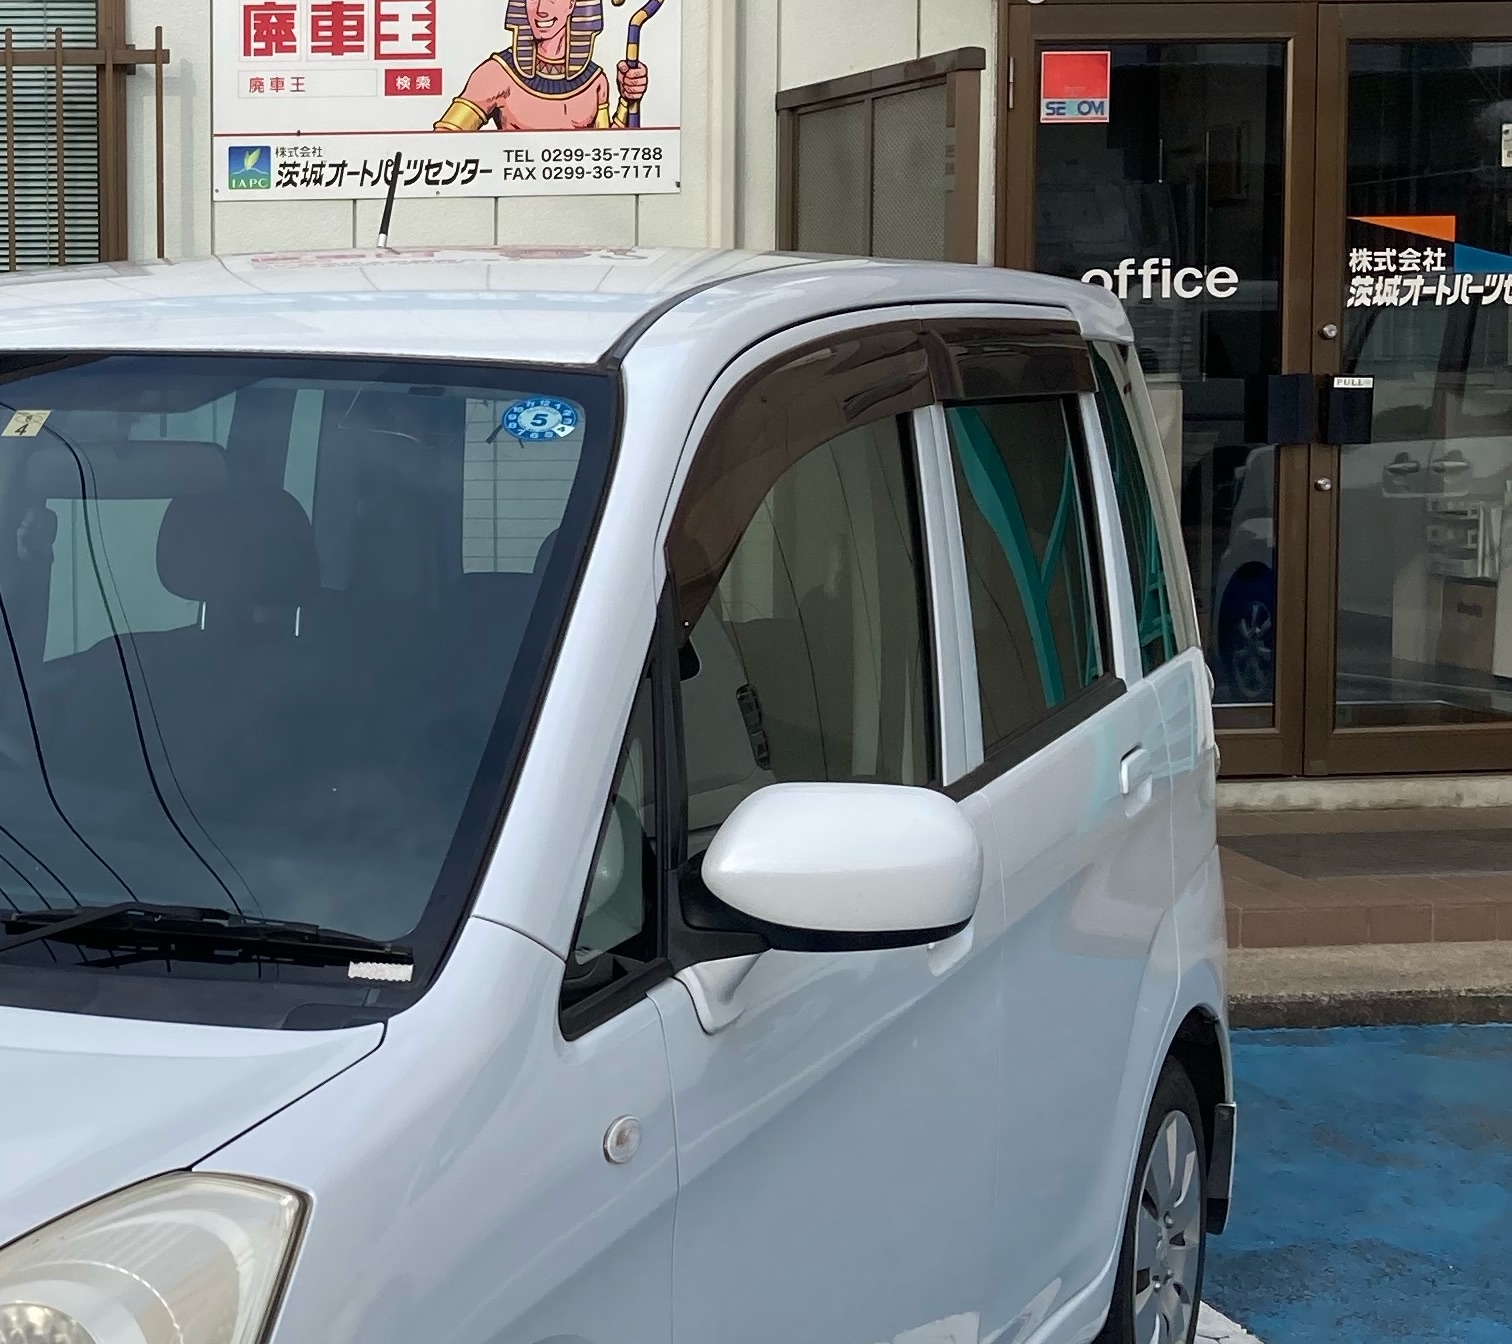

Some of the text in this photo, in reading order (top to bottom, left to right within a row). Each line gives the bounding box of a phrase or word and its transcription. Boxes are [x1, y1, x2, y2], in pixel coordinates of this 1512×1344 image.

[249, 76, 305, 93] 廃車王
[395, 75, 431, 90] 検索
[275, 146, 323, 157] 株式会社
[503, 147, 662, 162] TEL 0299-35-7788
[503, 165, 661, 180] FAX 0299-36-7171
[232, 178, 268, 188] IAPC
[1349, 247, 1446, 273] 株式会社
[1337, 378, 1364, 386] PULL
[530, 413, 548, 426] 5
[14, 423, 30, 435] 4
